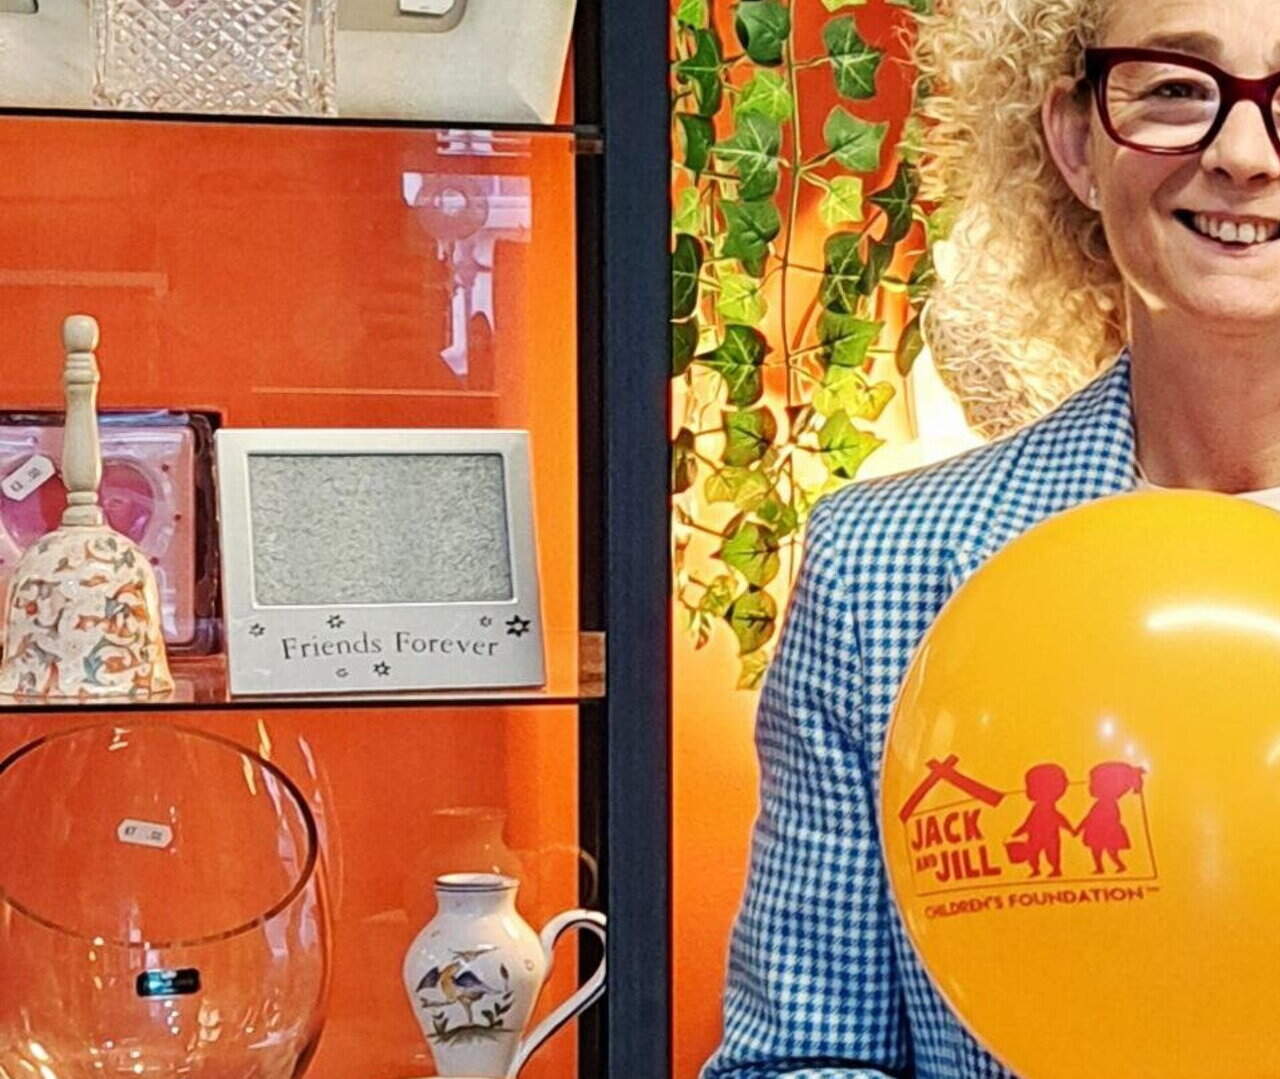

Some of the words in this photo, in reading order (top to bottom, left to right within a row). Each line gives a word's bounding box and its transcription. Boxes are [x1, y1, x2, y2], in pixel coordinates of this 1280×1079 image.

[281, 631, 383, 660] Friends
[396, 631, 500, 656] Forever
[911, 808, 984, 852] JACK
[916, 853, 938, 872] AND
[936, 845, 1002, 882] JILL
[925, 896, 1003, 919] CHILDREN'S
[1008, 887, 1145, 908] FOUNDATION
